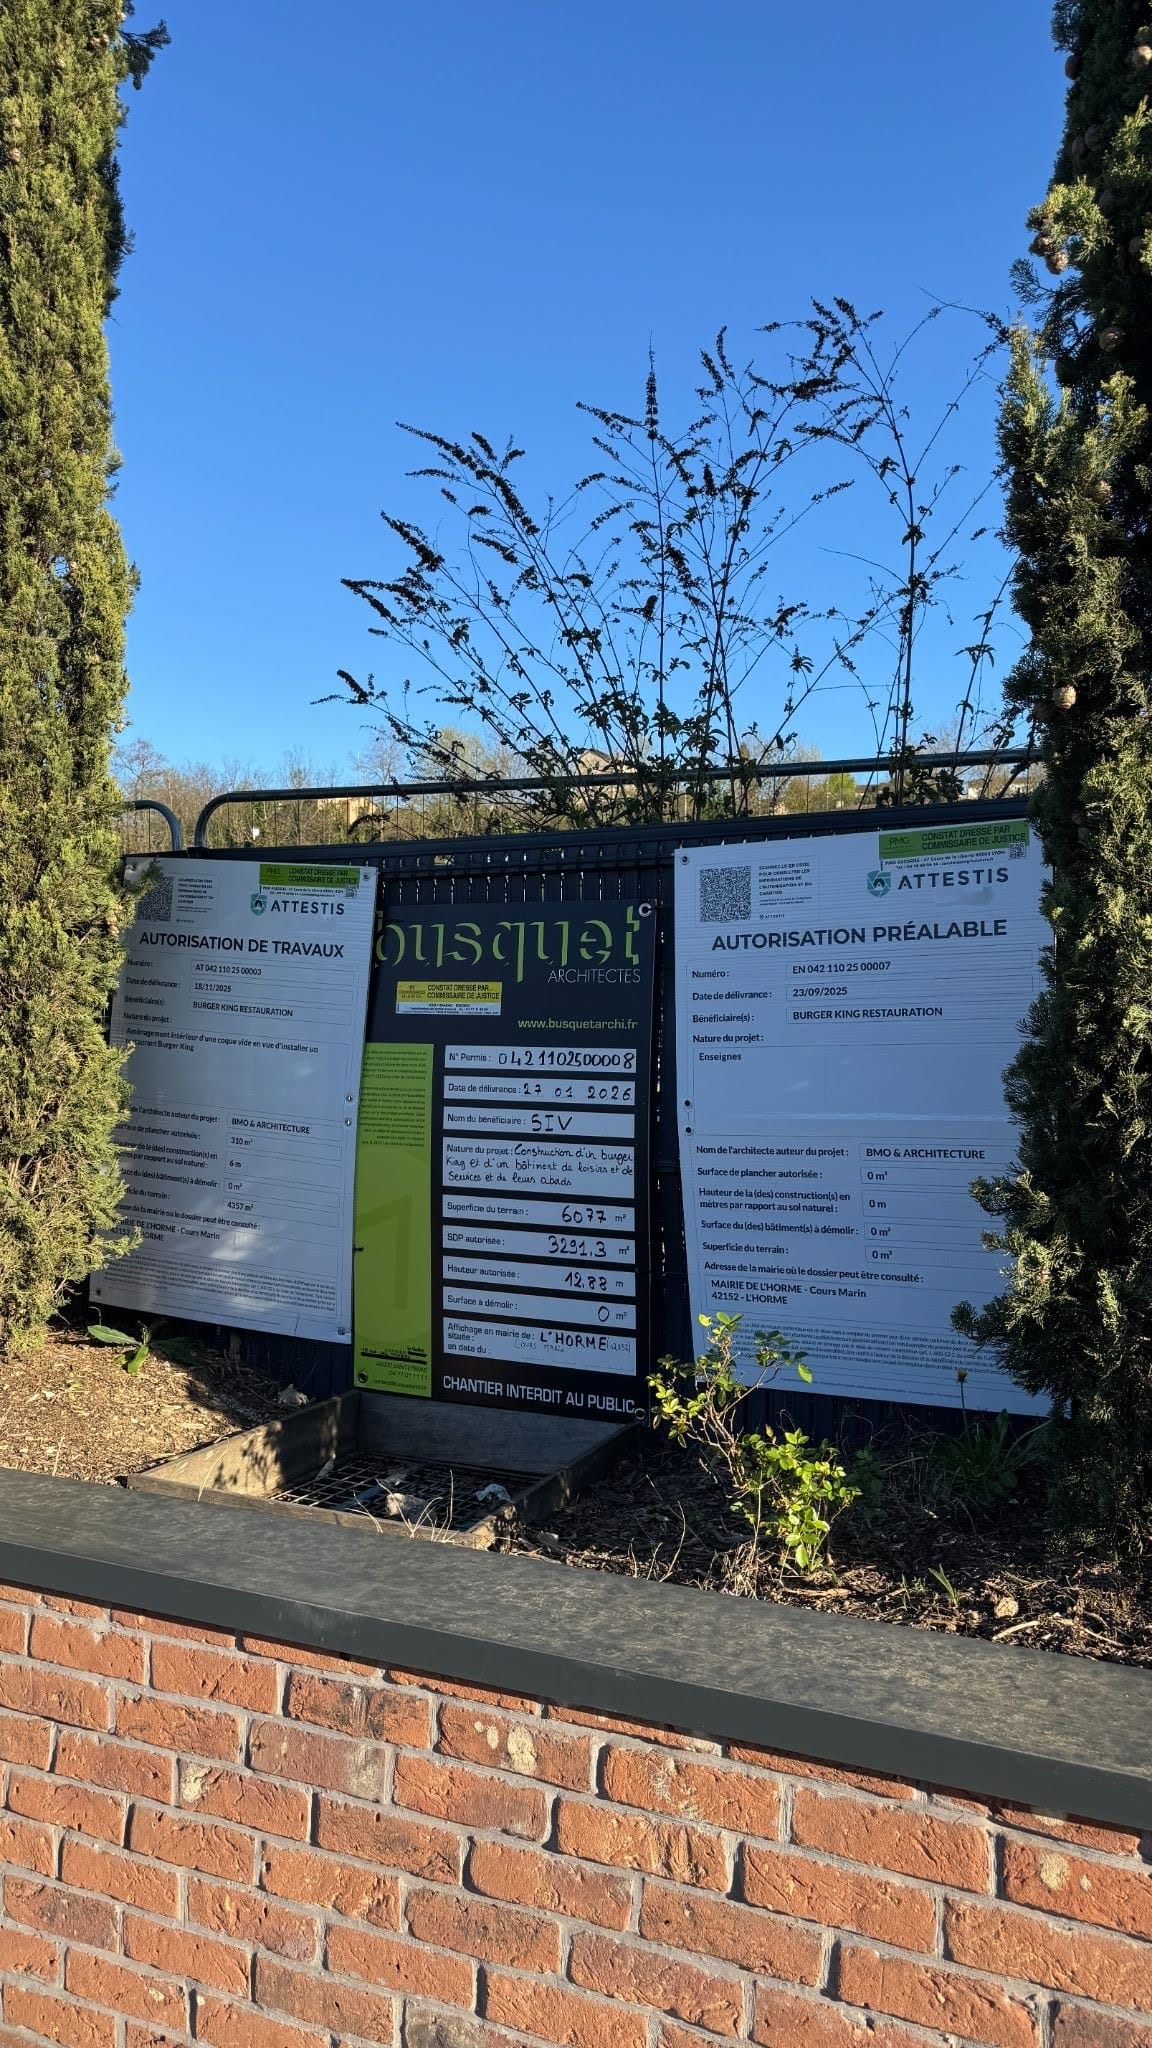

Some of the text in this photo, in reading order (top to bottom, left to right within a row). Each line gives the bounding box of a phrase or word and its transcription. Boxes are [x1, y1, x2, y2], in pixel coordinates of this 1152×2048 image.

[921, 825, 1010, 841] CONSTAT PAR
[921, 833, 1026, 850] COMMISSAIRE DE JUSTICE
[898, 867, 1009, 890] ATTESTIS
[270, 900, 345, 915] ATTESTIS
[712, 919, 1007, 951] AUTORISATION PRÉALABLE
[139, 932, 344, 958] AUTORISATION DE TRAVAUX
[218, 965, 230, 973] 110
[231, 966, 240, 974] 25
[240, 967, 262, 975] 00003
[548, 969, 641, 983] ARCHITECTES
[692, 961, 891, 978] Numéro EN 042 110 25 00007
[692, 986, 848, 1001] Date de délivrance 23/09/2025
[192, 1001, 294, 1017] BURGER KING RESTAURATION
[792, 1007, 943, 1020] BURGER KING RESTAURATION
[518, 1018, 638, 1030] www.busquetarchi.fr
[692, 1034, 760, 1044] Nature du projet
[158, 1040, 195, 1052] Burger King
[217, 1038, 237, 1046] coque
[238, 1038, 252, 1047] vide
[262, 1041, 275, 1049] vue
[275, 1041, 309, 1052] d'installer
[309, 1046, 319, 1054] un
[460, 1053, 487, 1061] Permis
[699, 1052, 742, 1062] Enseignes
[448, 1083, 517, 1093] Date de délivrance
[587, 1085, 632, 1101] 2026
[190, 1113, 199, 1121] du
[231, 1117, 249, 1127] BMO
[256, 1121, 310, 1134] ARCHITECTURE
[447, 1114, 522, 1124] Nom du bénéficiaire
[531, 1113, 573, 1132] SIV
[230, 1136, 243, 1145] 310
[446, 1144, 509, 1156] Nature du projet
[696, 1146, 986, 1159] Nom l'architecte auteur du projet BMO ARCHITECTURE
[469, 1158, 480, 1168] et
[485, 1173, 493, 1182] et
[697, 1167, 818, 1179] Surface de plancher autorisée
[699, 1188, 733, 1197] Hauteur
[733, 1189, 745, 1197] de
[754, 1190, 774, 1199] (des)
[226, 1201, 244, 1210] 4357
[729, 1202, 834, 1213] par rapport sol naturel
[447, 1201, 607, 1224] Superficie du terrain 6077
[180, 1227, 200, 1237] Cours
[200, 1230, 221, 1240] Marin
[701, 1220, 855, 1235] Surface du (des) bâtiment(s) démolir
[447, 1233, 464, 1242] SDP
[465, 1236, 502, 1245] autorisée
[702, 1241, 785, 1254] Superficie du terrain
[447, 1264, 478, 1275] Hauteur
[479, 1268, 516, 1278] autorisée
[704, 1262, 920, 1283] Adresse de mairie dossier peut être consulté
[711, 1280, 867, 1298] MAIRIE DE L'HORME Cours Marin
[447, 1294, 477, 1305] Surface
[484, 1299, 514, 1309] démolir
[711, 1291, 788, 1304] 42152 L'HORME
[447, 1323, 483, 1336] Affichage
[495, 1328, 520, 1338] mairie
[521, 1331, 531, 1340] de
[458, 1343, 487, 1354] date du
[443, 1375, 503, 1397] CHANTIER
[506, 1383, 562, 1404] INTERDIT
[565, 1392, 584, 1407] AU
[587, 1394, 636, 1414] PUBLIC
